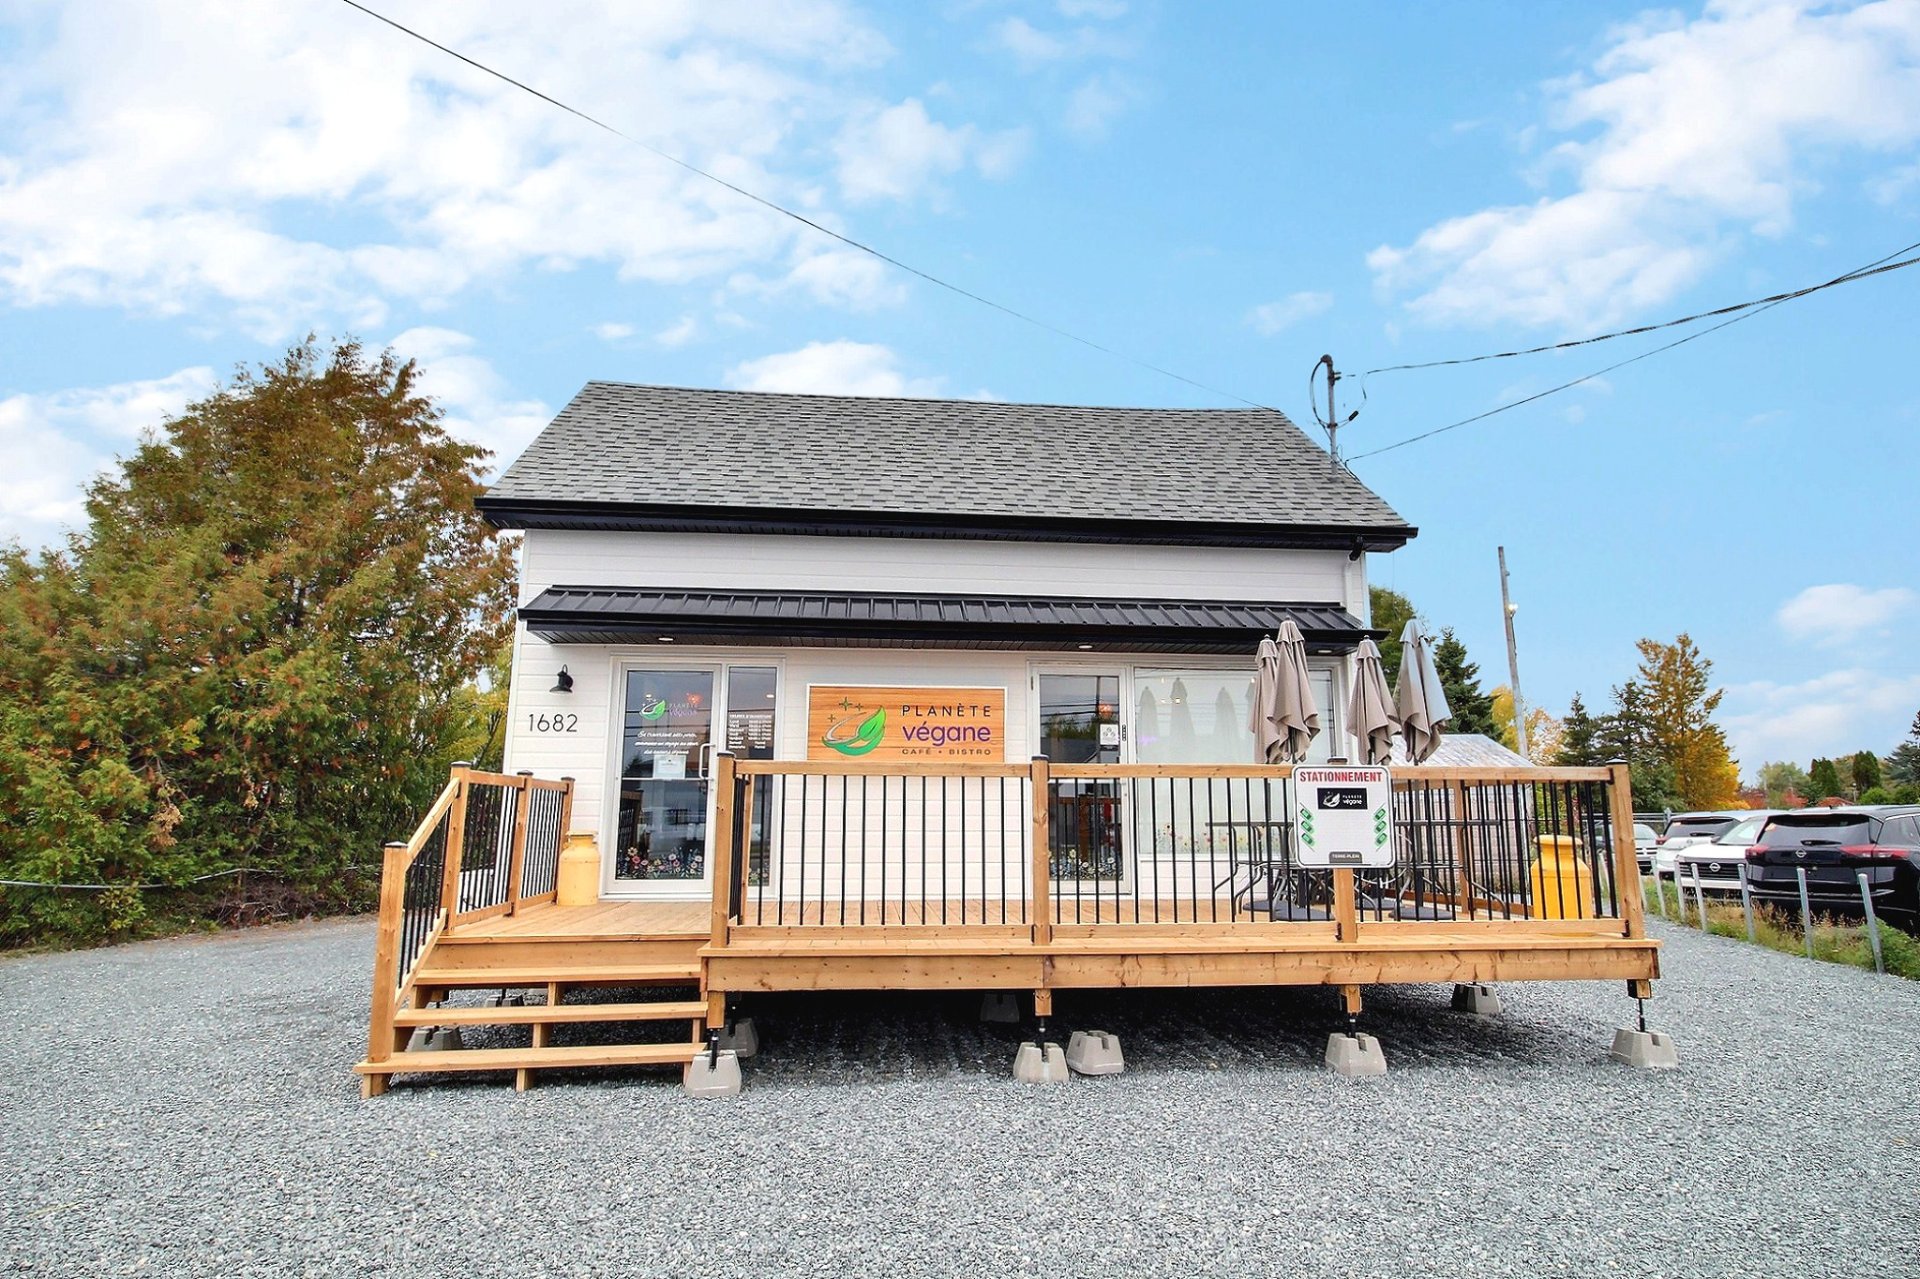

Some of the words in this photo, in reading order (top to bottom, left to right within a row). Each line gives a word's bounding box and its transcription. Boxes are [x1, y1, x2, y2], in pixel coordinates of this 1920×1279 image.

[902, 703, 991, 717] PLANÈTE
[529, 713, 578, 732] 1682
[902, 721, 991, 746] végane
[901, 747, 931, 755] CAFÉ
[948, 748, 991, 756] BISTRO
[1299, 771, 1383, 782] STATIONNEMENT
